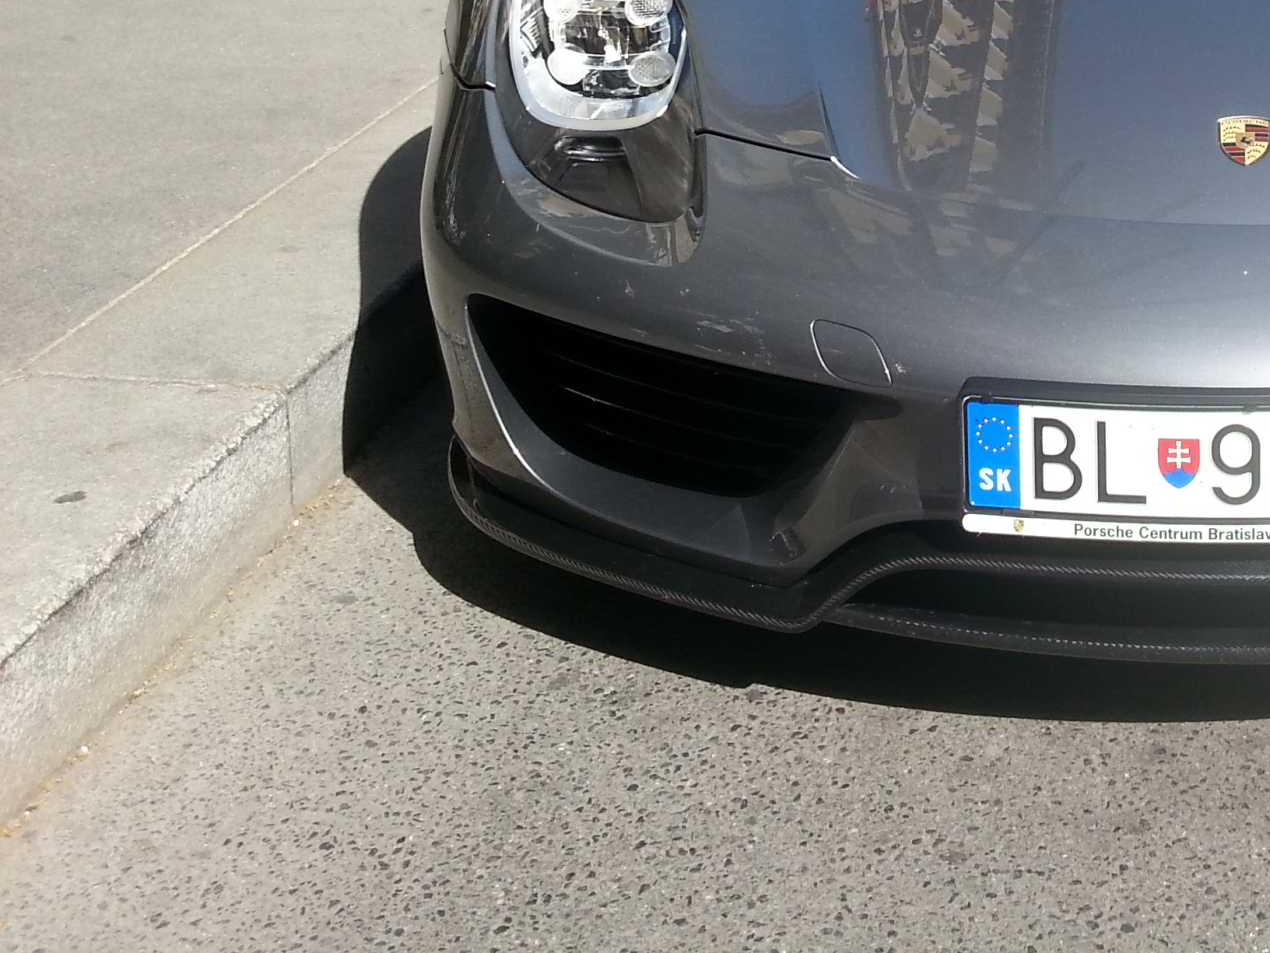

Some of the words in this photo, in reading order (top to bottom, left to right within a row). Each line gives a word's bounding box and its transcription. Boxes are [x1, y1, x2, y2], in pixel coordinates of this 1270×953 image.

[1033, 416, 1147, 505] BL
[978, 468, 1012, 492] SK
[1074, 524, 1133, 539] Porsche
[1139, 524, 1203, 541] Centrum
